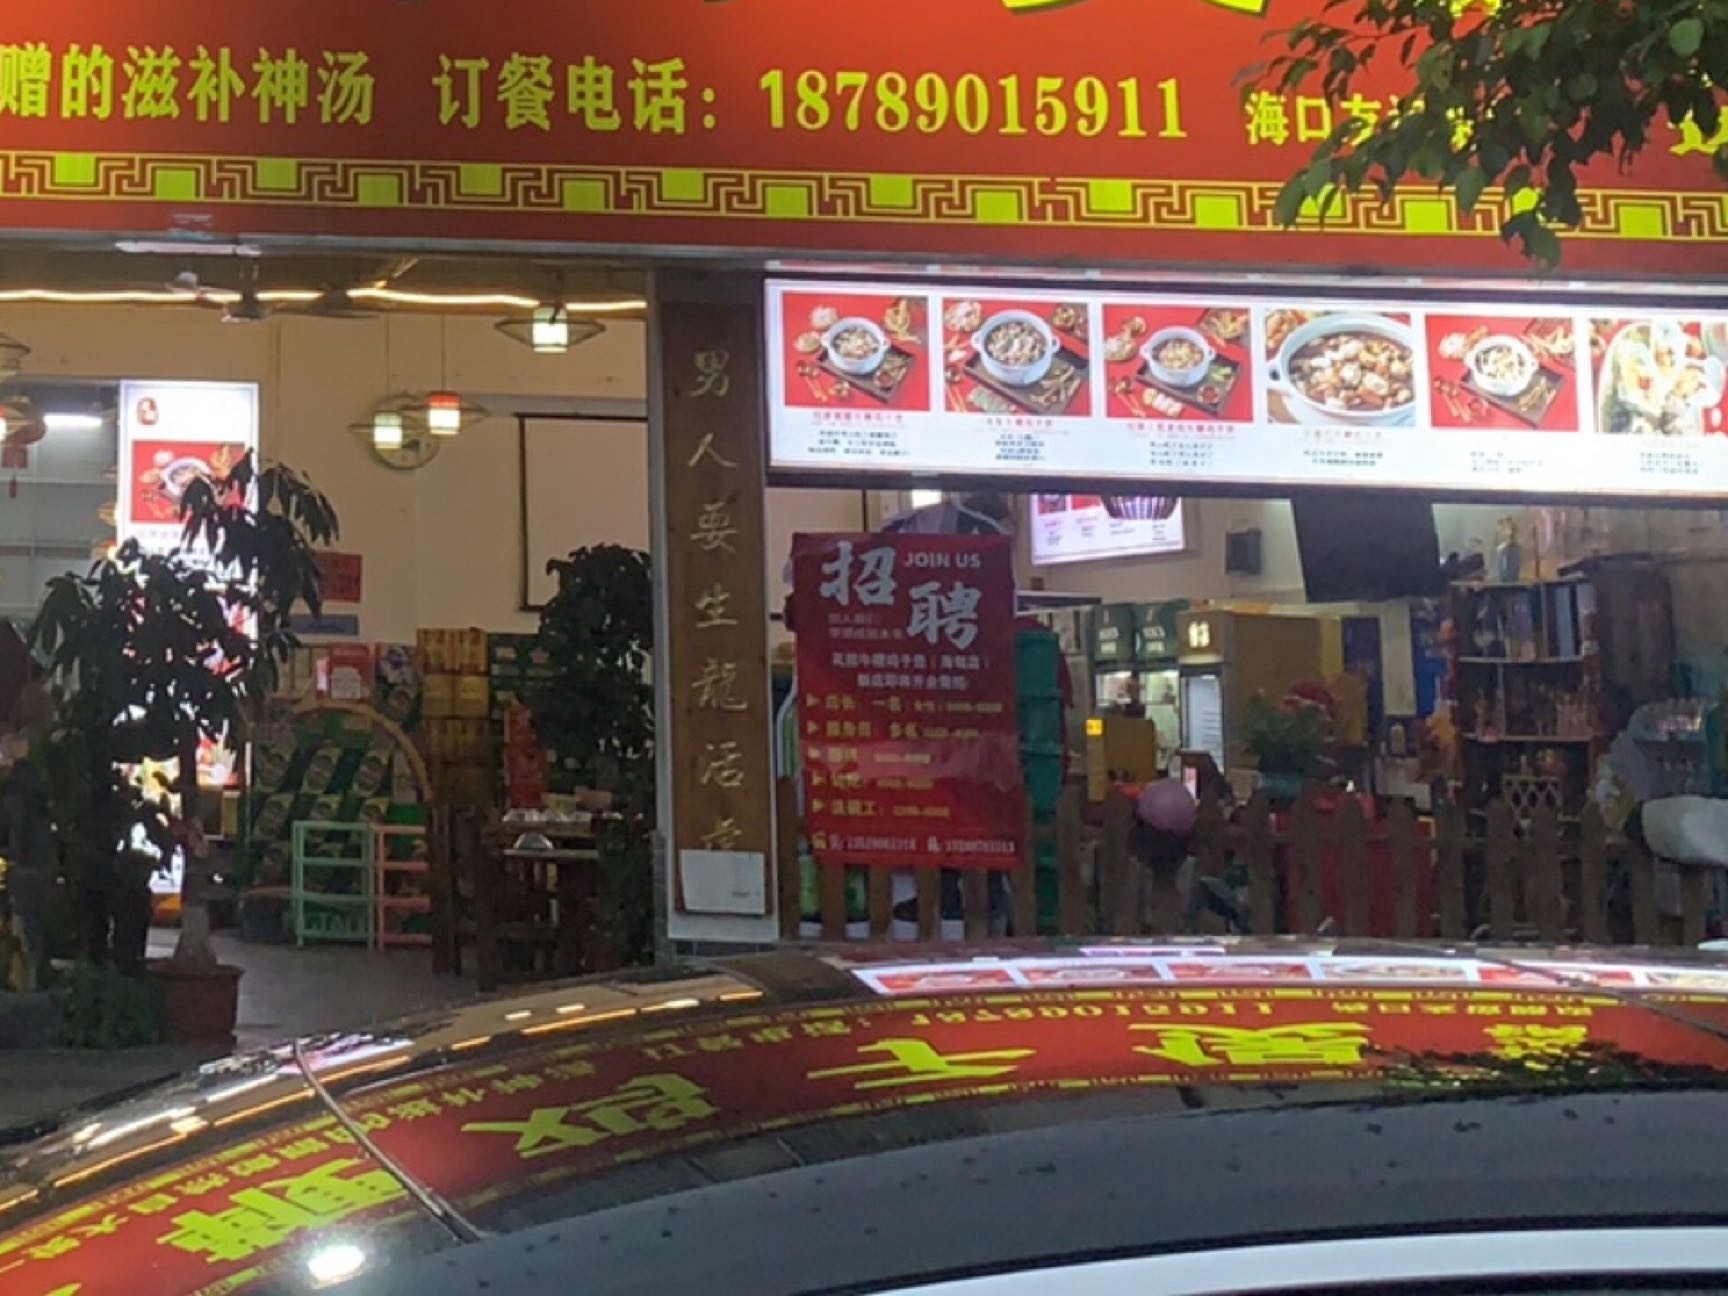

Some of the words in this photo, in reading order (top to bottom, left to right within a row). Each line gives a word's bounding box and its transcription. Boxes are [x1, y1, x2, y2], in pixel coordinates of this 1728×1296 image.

[760, 68, 1188, 139] 18789015911
[820, 540, 981, 651] 招聘
[903, 552, 950, 568] JOIN
[955, 553, 981, 568] US
